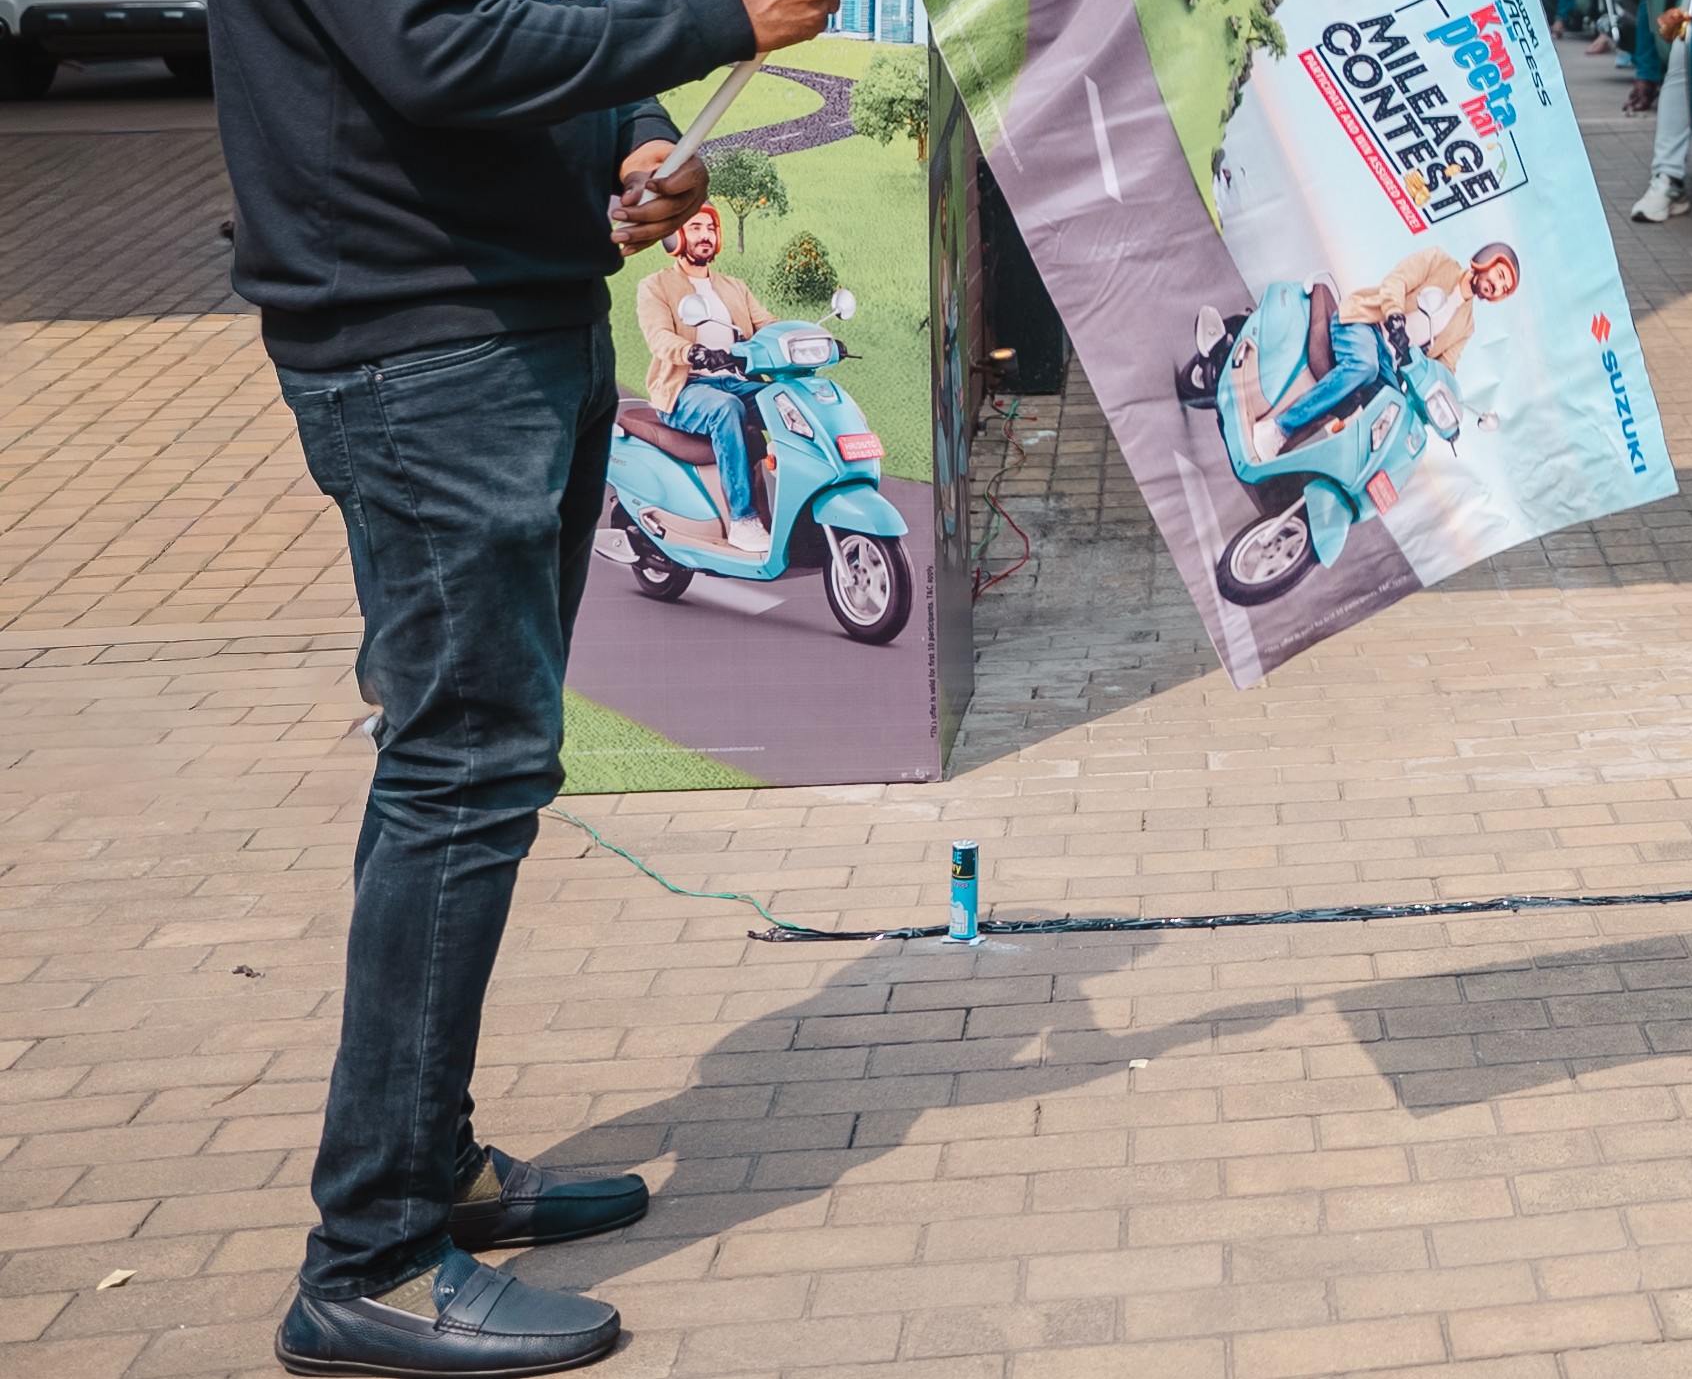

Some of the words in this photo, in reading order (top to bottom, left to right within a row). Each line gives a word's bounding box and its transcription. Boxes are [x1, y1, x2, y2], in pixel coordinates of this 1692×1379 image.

[1303, 54, 1347, 114] PARTICIPATE
[1340, 113, 1360, 135] AND
[1322, 21, 1471, 212] CONTEST
[1356, 12, 1500, 200] MILEAGE
[1424, 15, 1517, 130] peeta
[1602, 349, 1647, 475] SUZUKI
[926, 585, 934, 599] T&C
[927, 642, 935, 651] 10
